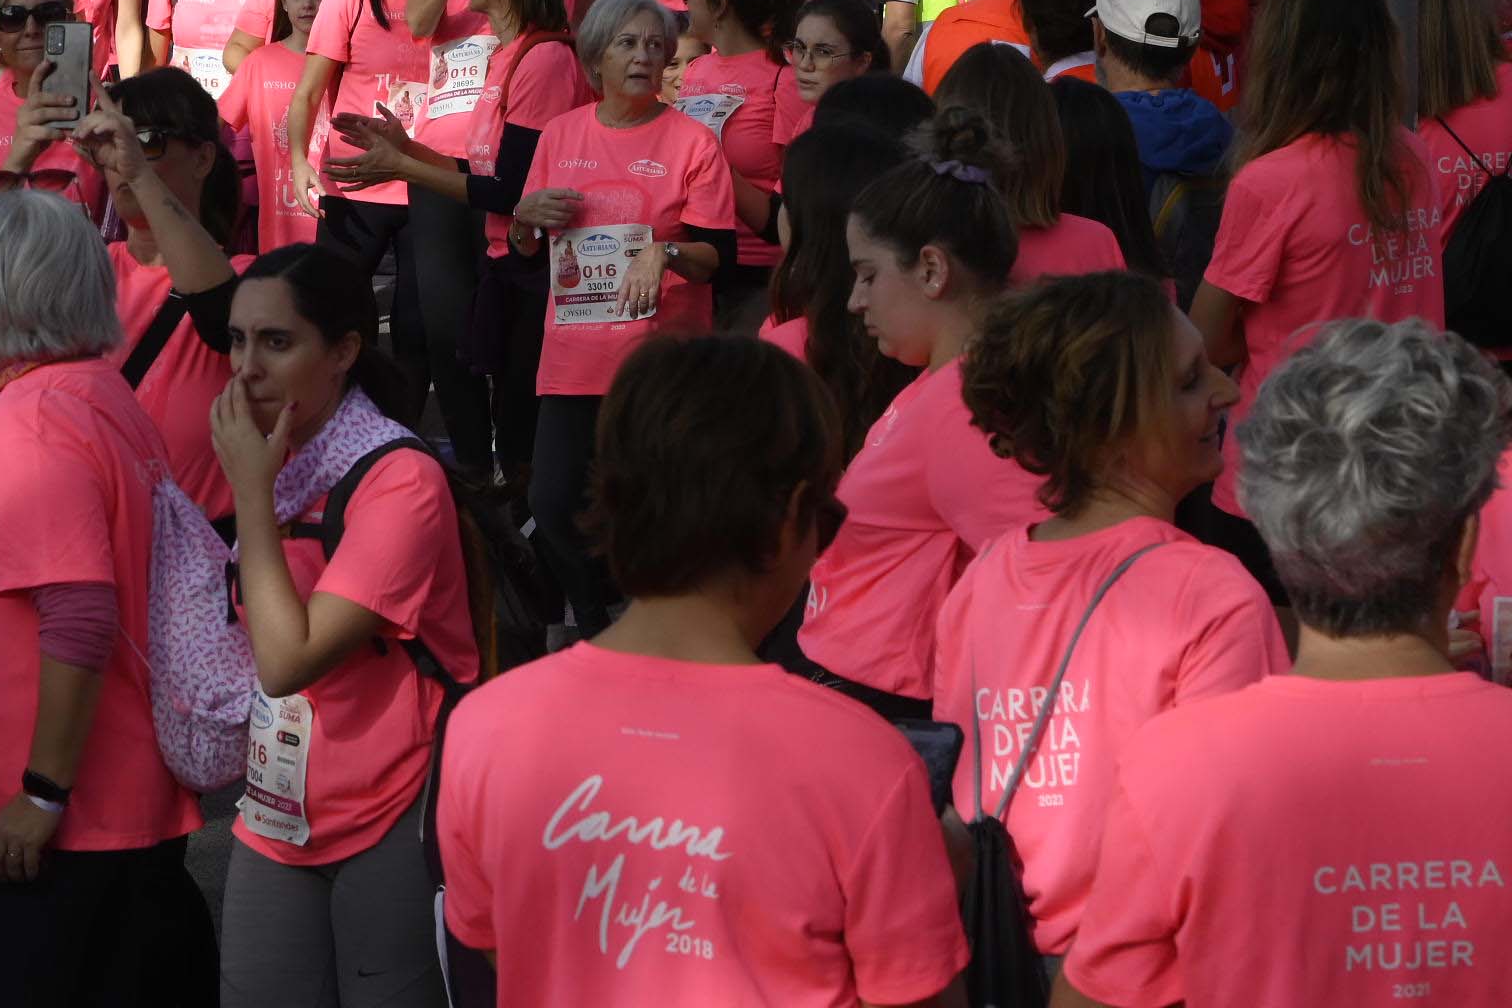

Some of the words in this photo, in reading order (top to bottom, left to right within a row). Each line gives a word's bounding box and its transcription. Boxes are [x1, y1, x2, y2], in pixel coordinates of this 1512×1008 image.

[450, 65, 479, 79] 016
[452, 79, 475, 89] 28695
[579, 242, 617, 252] ASTURIANA
[583, 263, 617, 279] 016
[1368, 255, 1436, 289] MUJER
[587, 281, 614, 292] 33010
[278, 710, 301, 725] SUMA
[542, 774, 732, 862] Carrera
[1313, 857, 1505, 895] CARRERA
[573, 853, 696, 970] Mujer
[1351, 901, 1402, 934] DE
[1416, 900, 1468, 930] LA
[665, 931, 714, 960] 2018
[1345, 940, 1475, 972] MUJER
